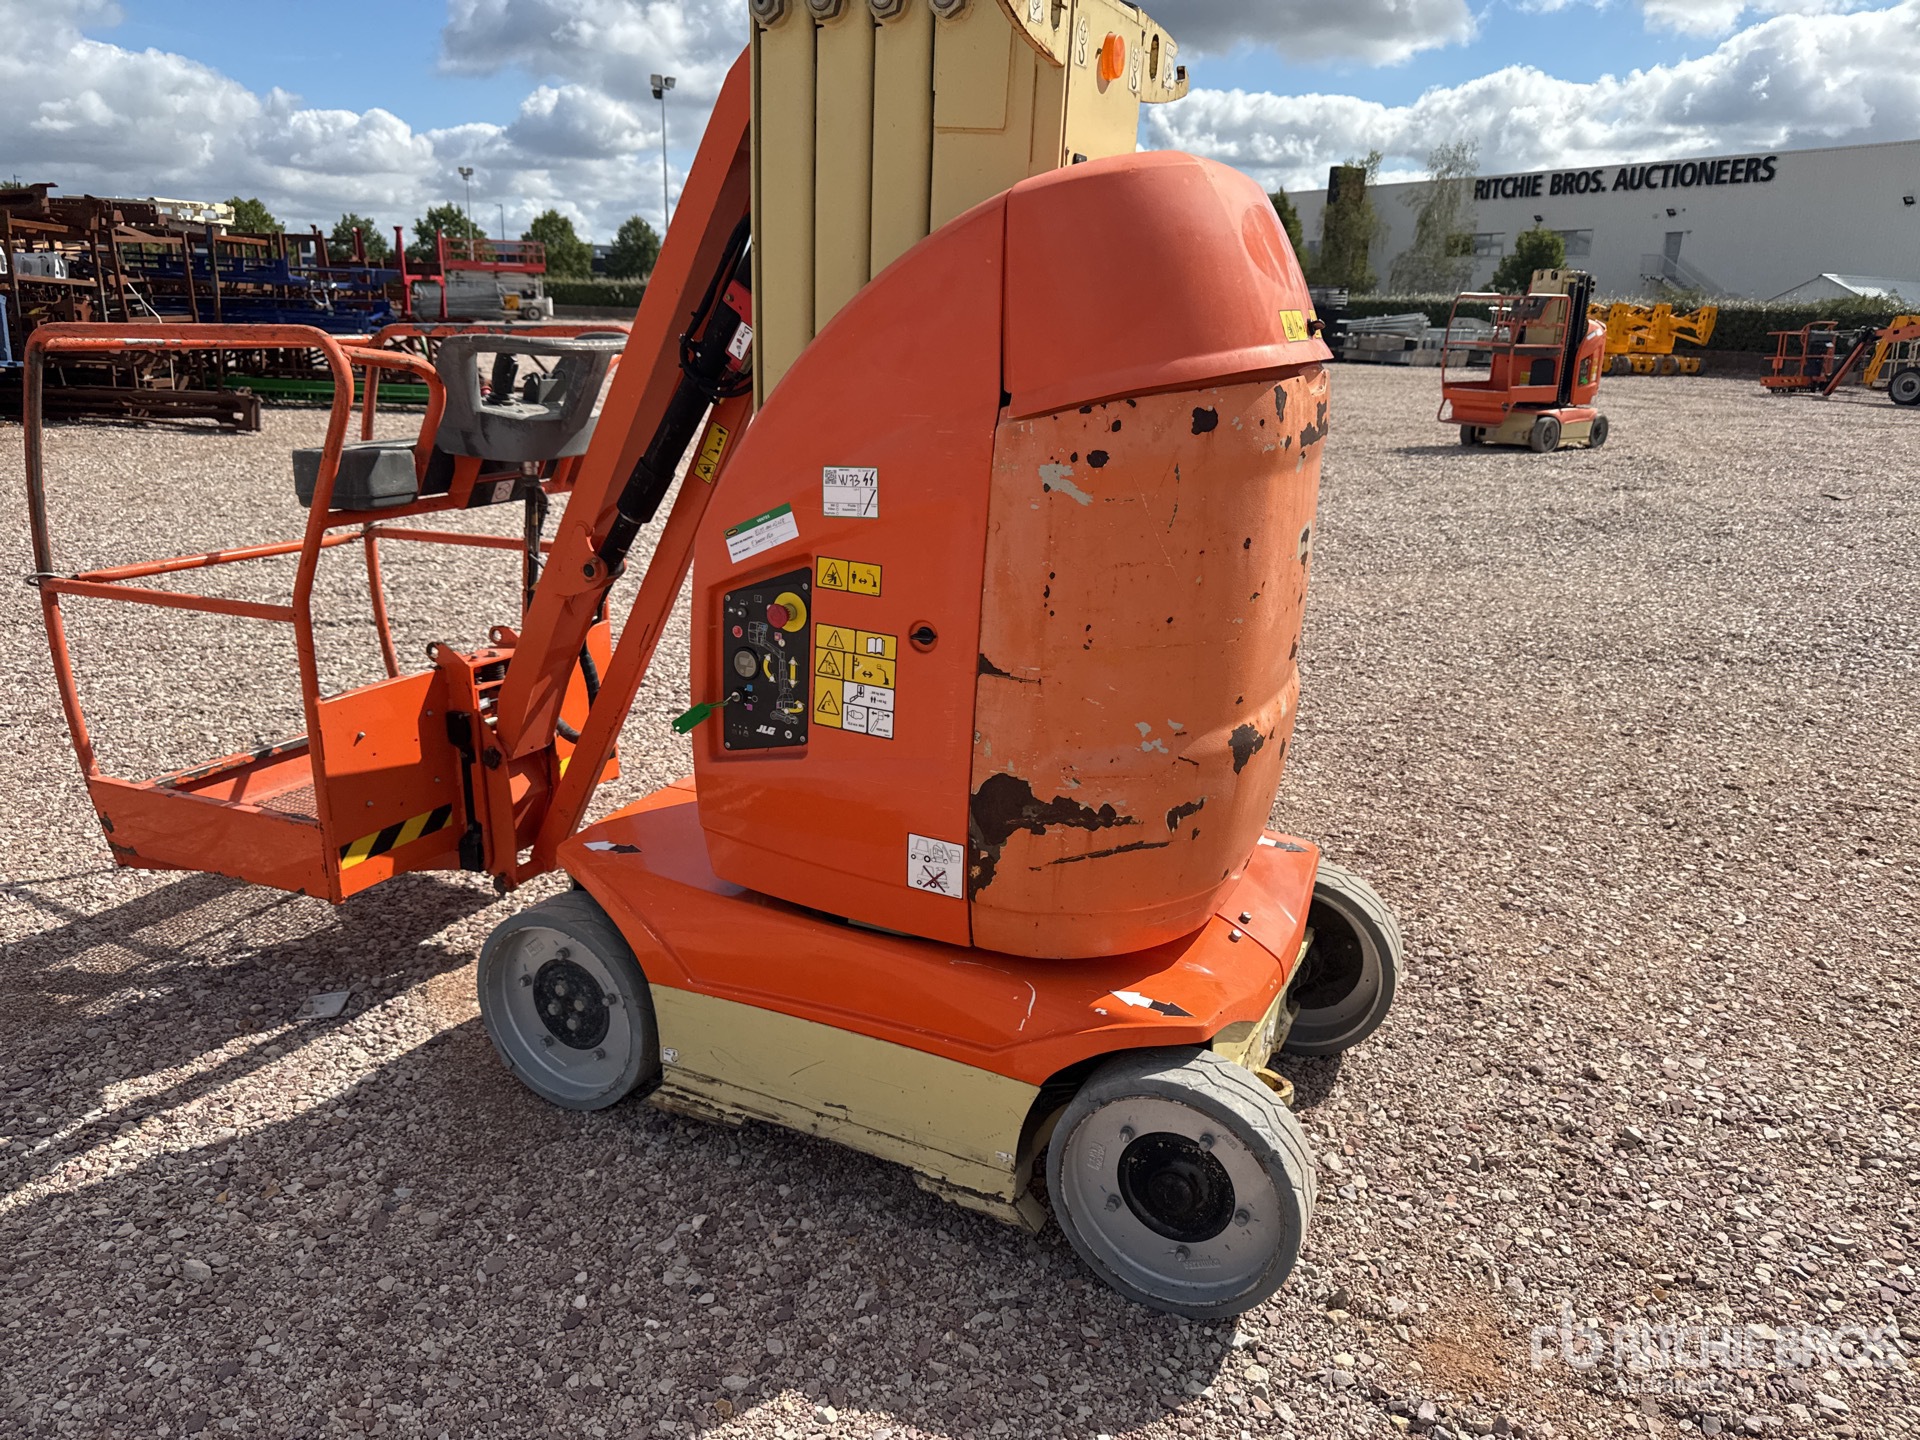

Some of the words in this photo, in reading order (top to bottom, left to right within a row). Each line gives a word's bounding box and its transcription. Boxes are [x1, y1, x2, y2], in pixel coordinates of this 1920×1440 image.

[1473, 174, 1543, 200] RITCHIE
[1549, 169, 1607, 196] BROS.
[1612, 155, 1778, 192] AUCTIONEERS
[756, 724, 776, 736] JLG
